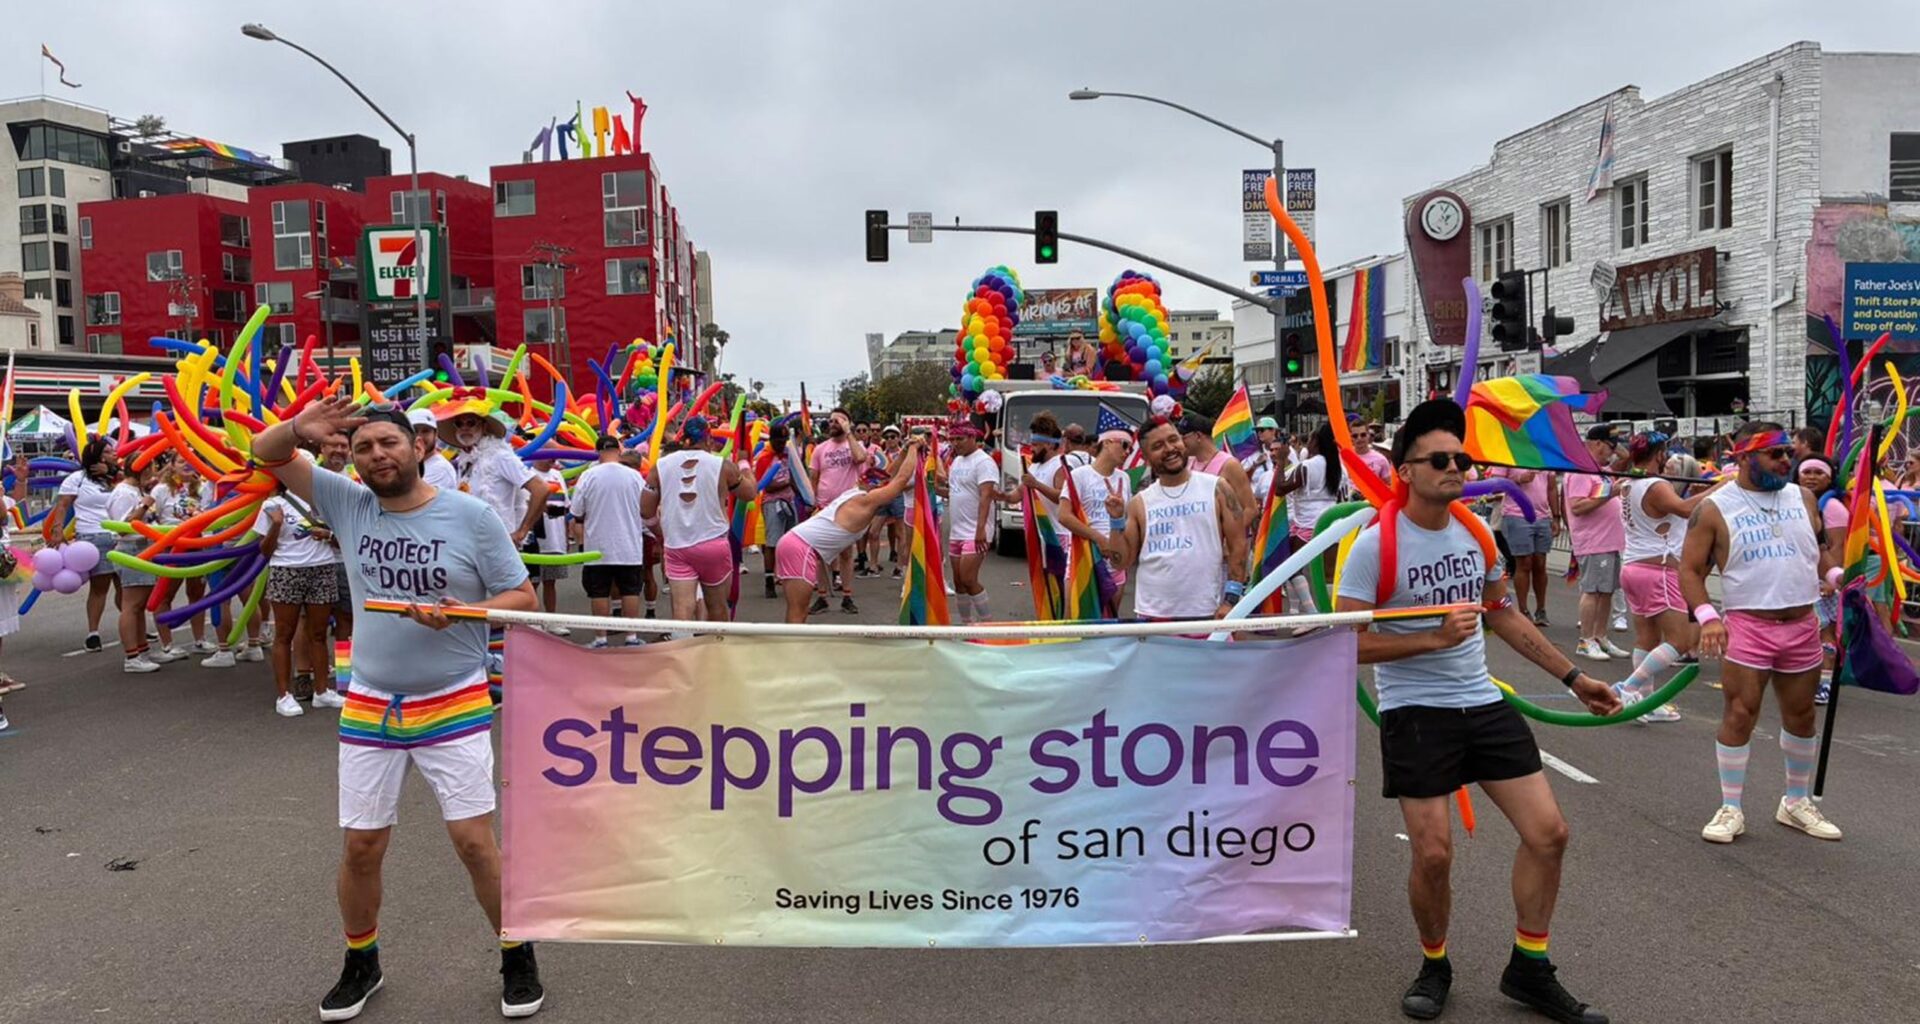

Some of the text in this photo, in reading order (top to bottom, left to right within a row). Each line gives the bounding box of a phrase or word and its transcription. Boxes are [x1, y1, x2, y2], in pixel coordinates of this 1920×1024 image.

[1244, 173, 1270, 182] PARK
[1287, 172, 1313, 181] PARK
[1244, 182, 1266, 192] FRE
[1288, 181, 1313, 191] FREE
[1288, 200, 1313, 210] DMV
[379, 266, 417, 279] ELEVE
[1603, 263, 1714, 323] AWOL
[1854, 279, 1887, 290] Father
[1888, 279, 1913, 290] Joe's
[1018, 295, 1072, 322] URIOUS
[1854, 296, 1880, 306] Thrift
[1883, 297, 1909, 306] Store
[1853, 309, 1918, 318] and Donation
[1853, 321, 1918, 333] Drop off only.
[1148, 501, 1207, 520] PROTECT
[1149, 521, 1174, 537] THE
[1740, 528, 1772, 545] THE
[358, 535, 447, 564] PROTECT
[1148, 536, 1193, 553] DOLLS
[1743, 543, 1797, 562] DOLLS
[1407, 550, 1478, 589] PROTECT
[361, 563, 376, 577] THE
[379, 566, 447, 596] DOLLS
[1432, 576, 1484, 605] DOLLS
[541, 702, 1320, 826] stepping stone
[982, 810, 1316, 867] of san diego
[775, 886, 1080, 915] Saving Lives Since 1976
